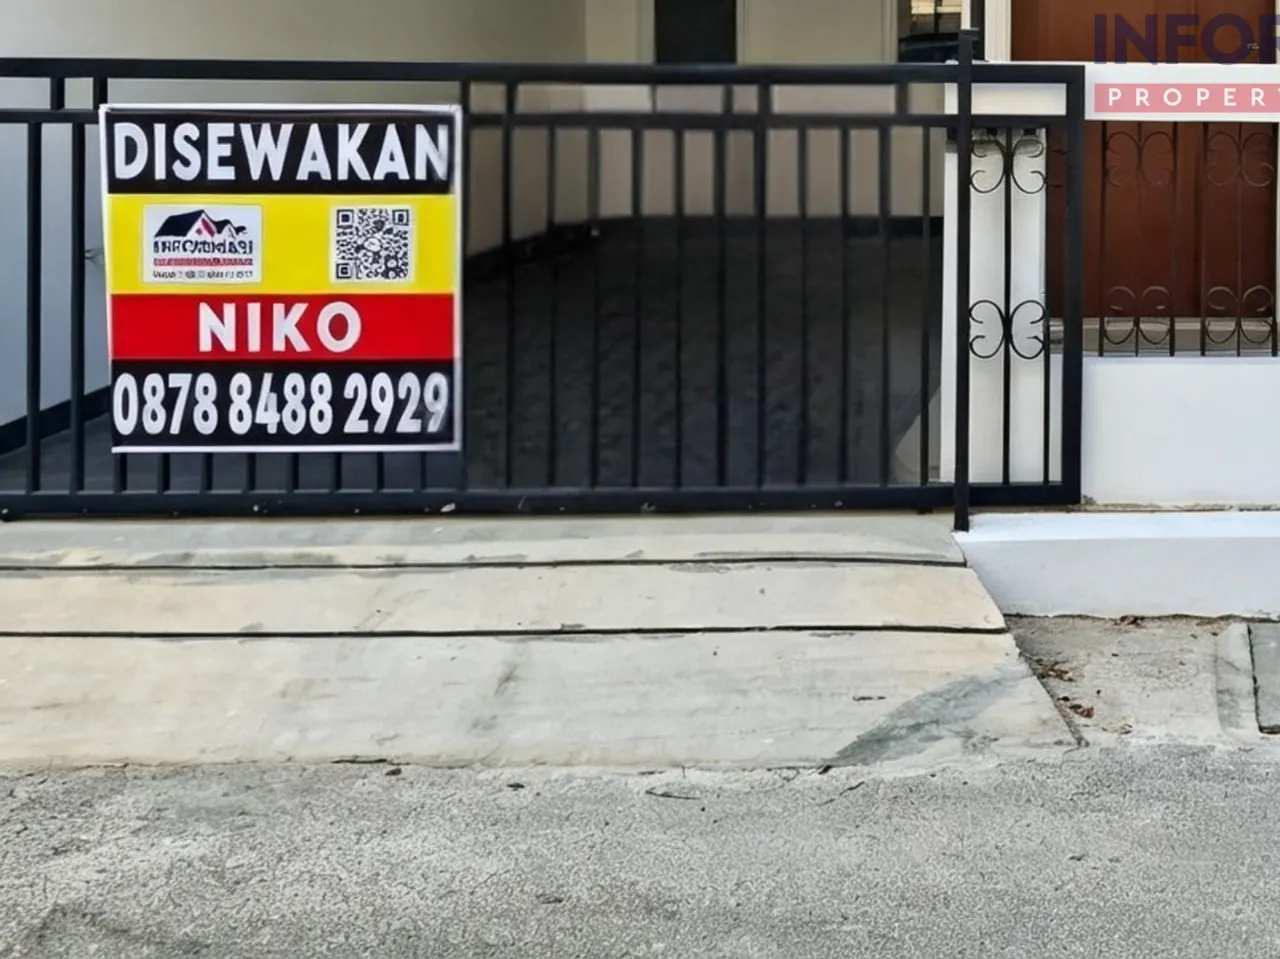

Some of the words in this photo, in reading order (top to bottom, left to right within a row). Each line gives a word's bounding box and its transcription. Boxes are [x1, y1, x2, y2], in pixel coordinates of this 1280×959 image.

[113, 122, 449, 181] DISEWAKAN
[199, 301, 362, 353] NIKO
[112, 372, 218, 436] 0878
[228, 371, 333, 435] 8488
[343, 371, 449, 434] 2929
